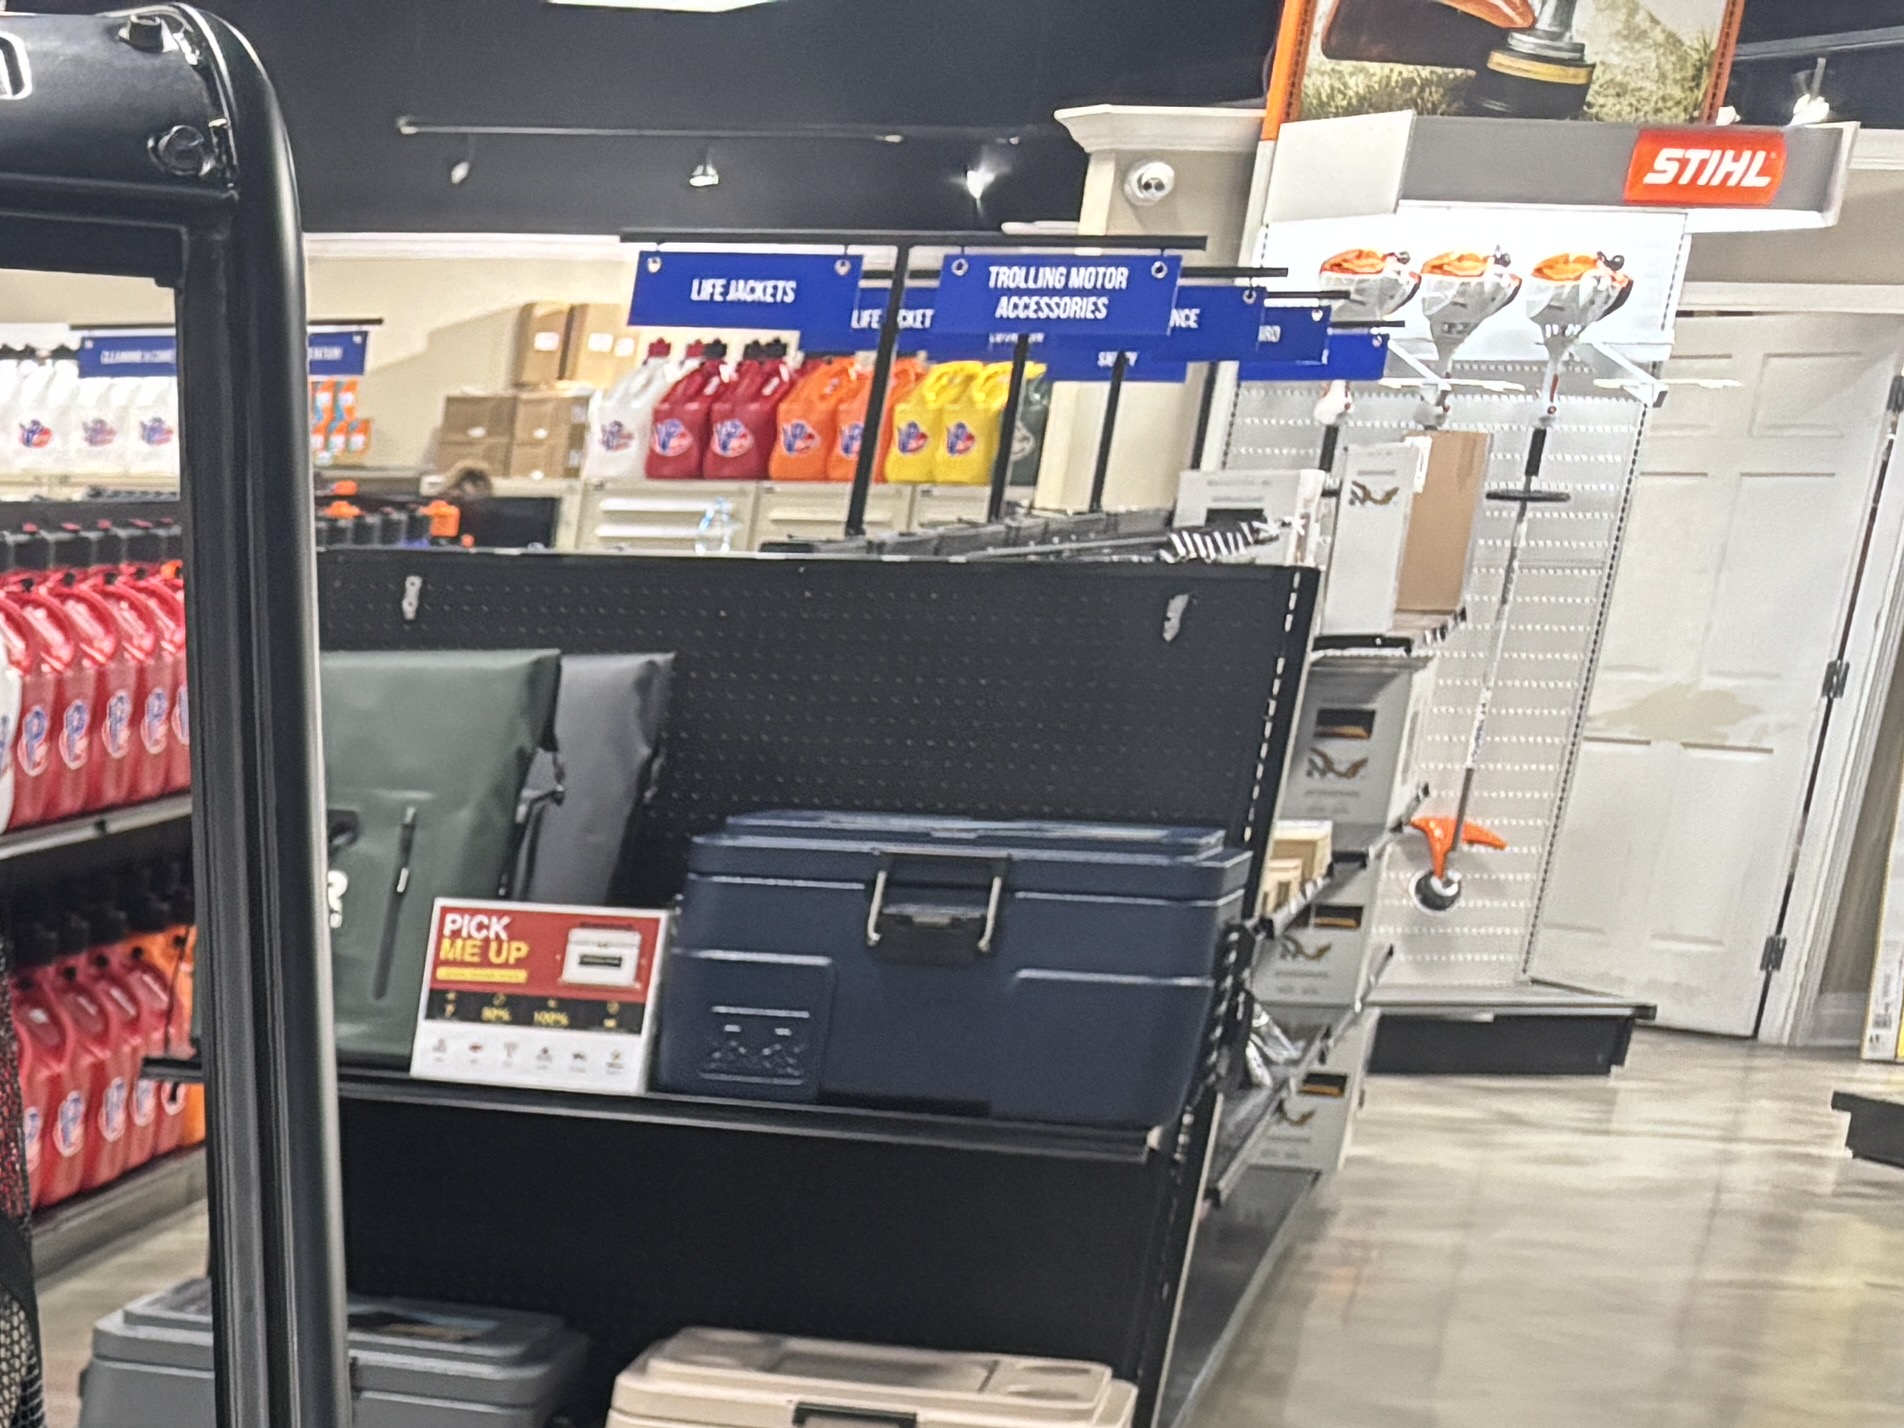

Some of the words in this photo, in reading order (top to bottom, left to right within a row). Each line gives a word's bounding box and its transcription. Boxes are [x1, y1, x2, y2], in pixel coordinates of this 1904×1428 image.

[1643, 147, 1772, 188] STIHL
[988, 265, 1067, 290] TROLLING
[1068, 266, 1129, 290] MOTOR
[690, 278, 725, 303] LIFE
[726, 278, 798, 304] JACKETS
[850, 308, 883, 330] LIFE
[994, 295, 1110, 320] ACCESSORIES
[443, 912, 512, 941] PICK
[439, 938, 484, 963] ME
[489, 939, 531, 965] UP
